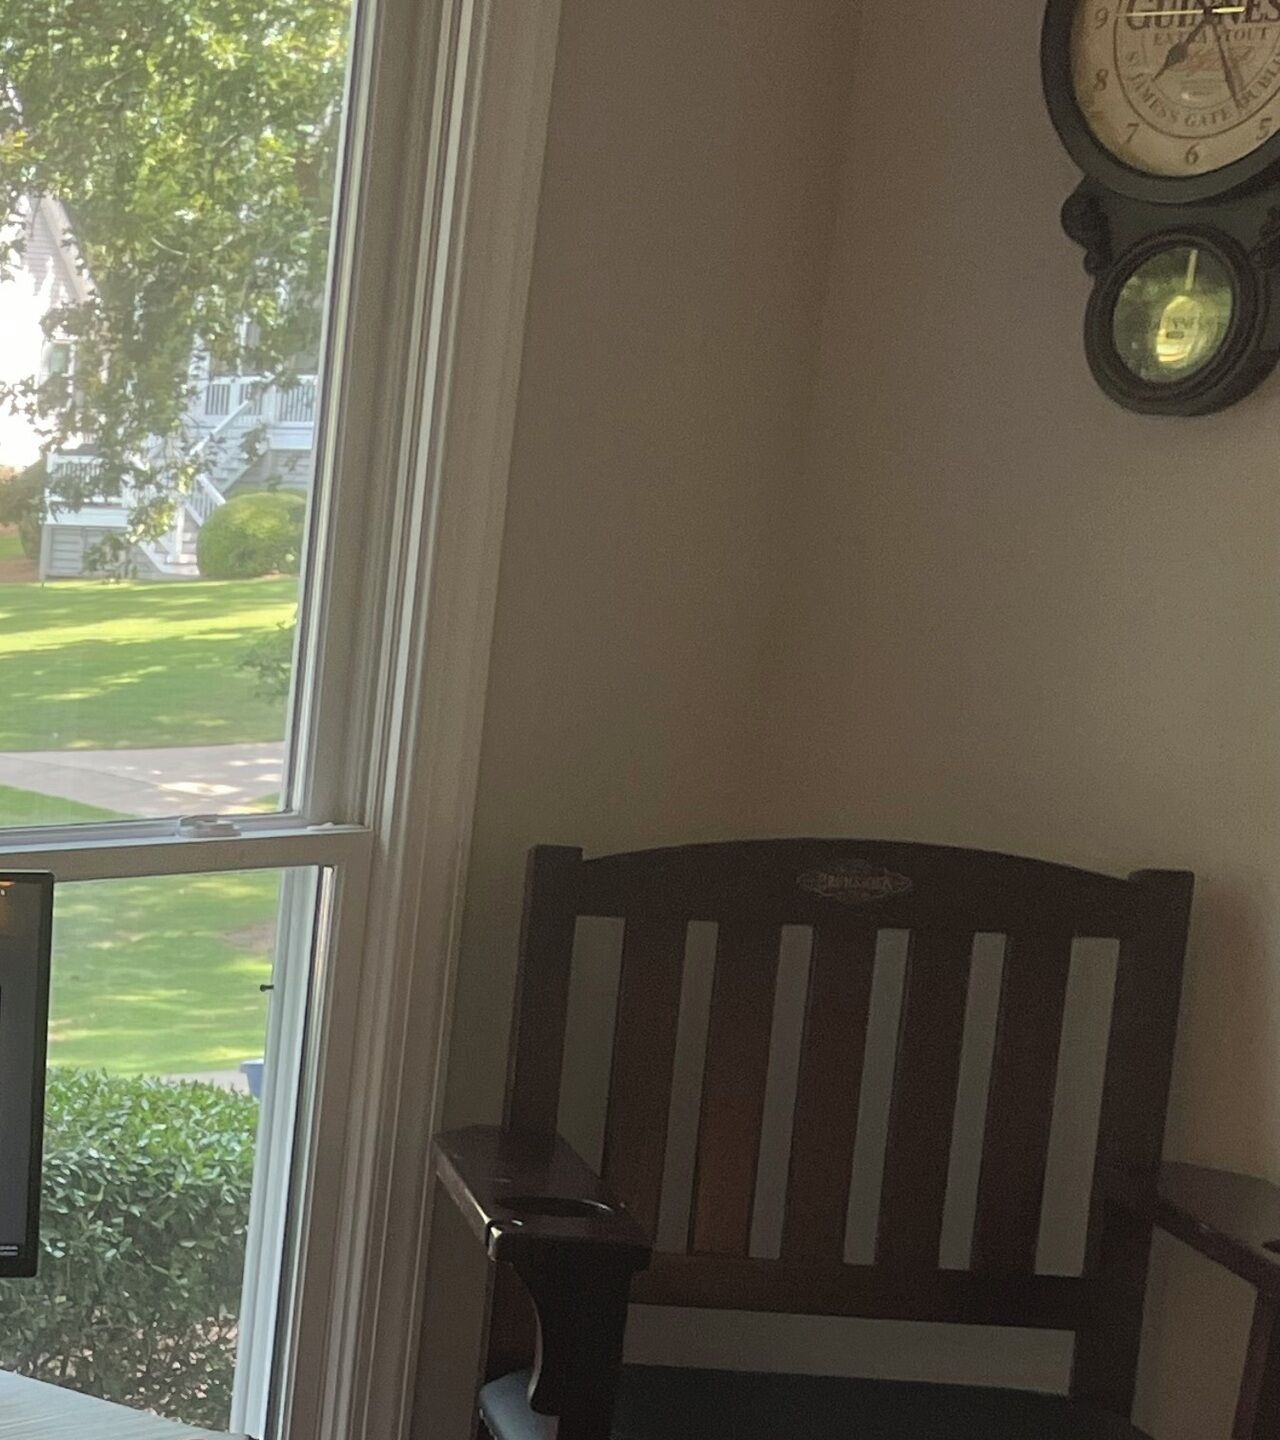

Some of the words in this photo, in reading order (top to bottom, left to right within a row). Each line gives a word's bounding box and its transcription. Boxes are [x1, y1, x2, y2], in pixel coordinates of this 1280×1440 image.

[1095, 8, 1109, 29] 9
[1096, 69, 1109, 92] 8
[1126, 123, 1140, 145] 7
[1256, 117, 1273, 142] 5
[1186, 142, 1200, 165] 6
